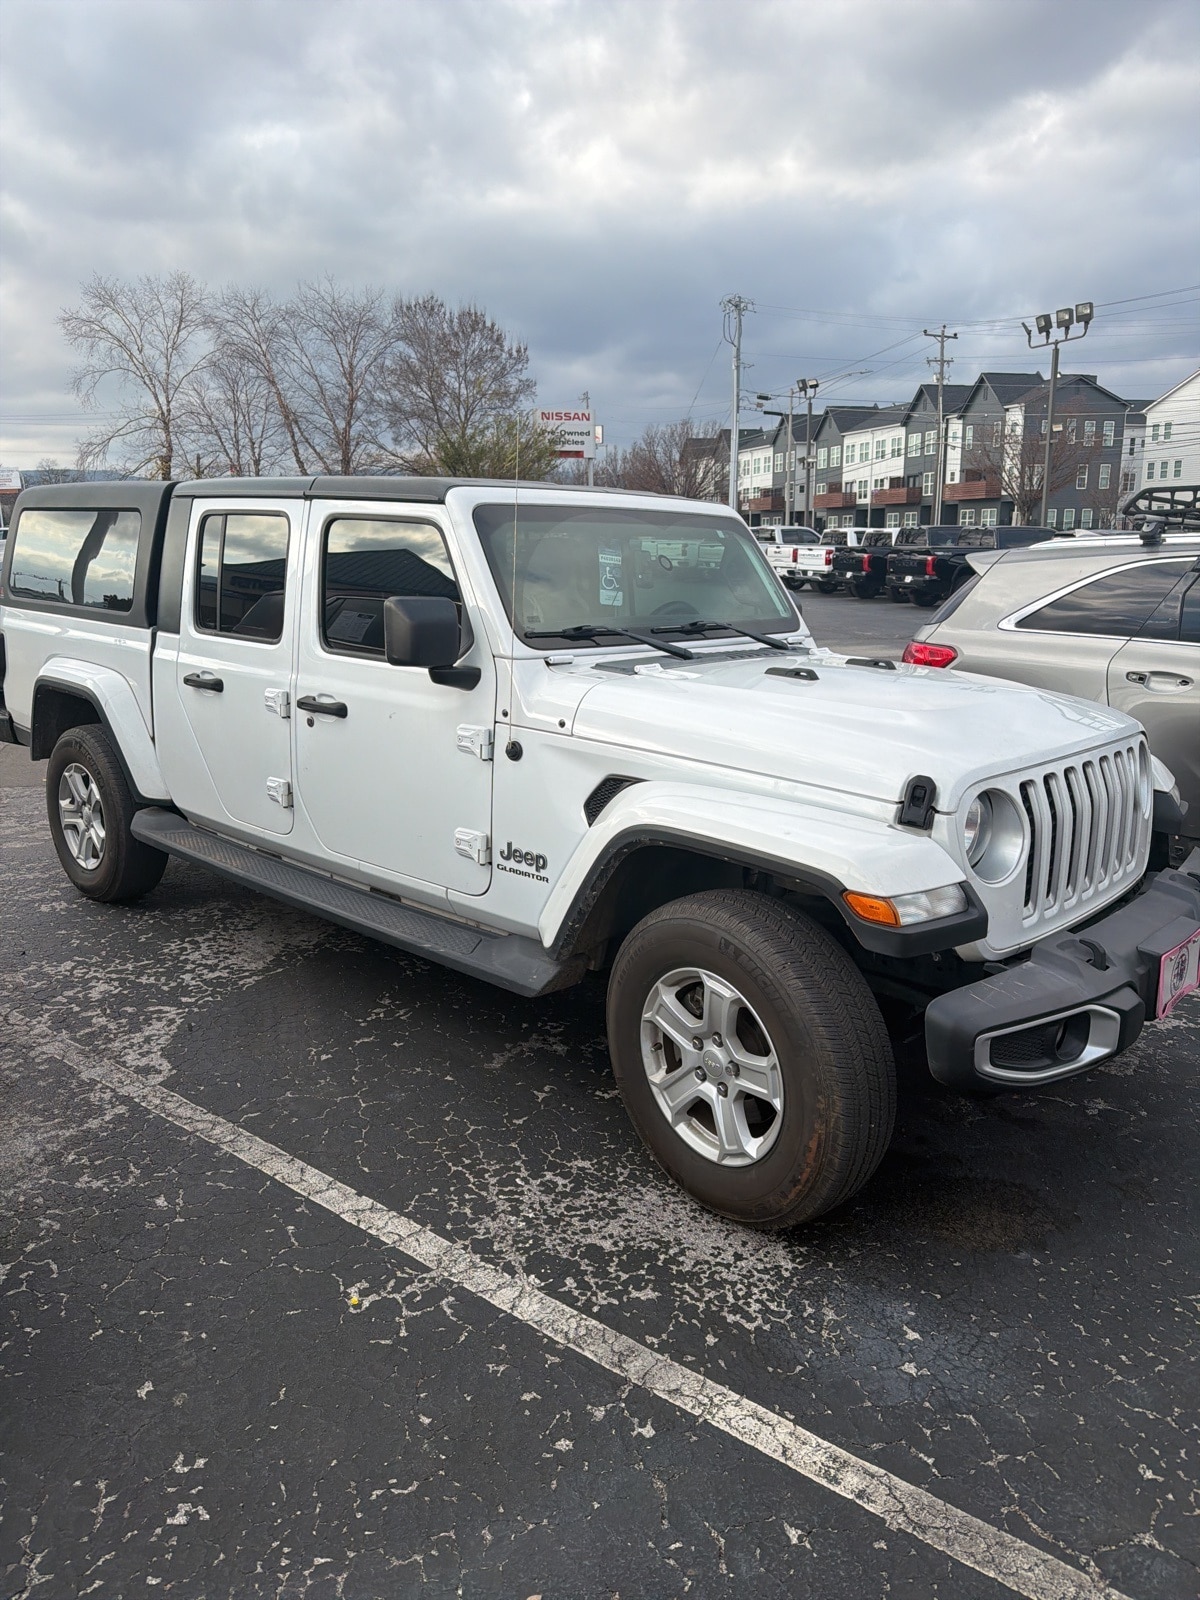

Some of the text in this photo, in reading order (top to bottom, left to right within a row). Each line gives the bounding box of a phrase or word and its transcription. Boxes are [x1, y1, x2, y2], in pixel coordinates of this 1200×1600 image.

[541, 411, 591, 421] NISSAN
[499, 840, 548, 873] Jeep
[496, 863, 550, 884] GLADIATOR
